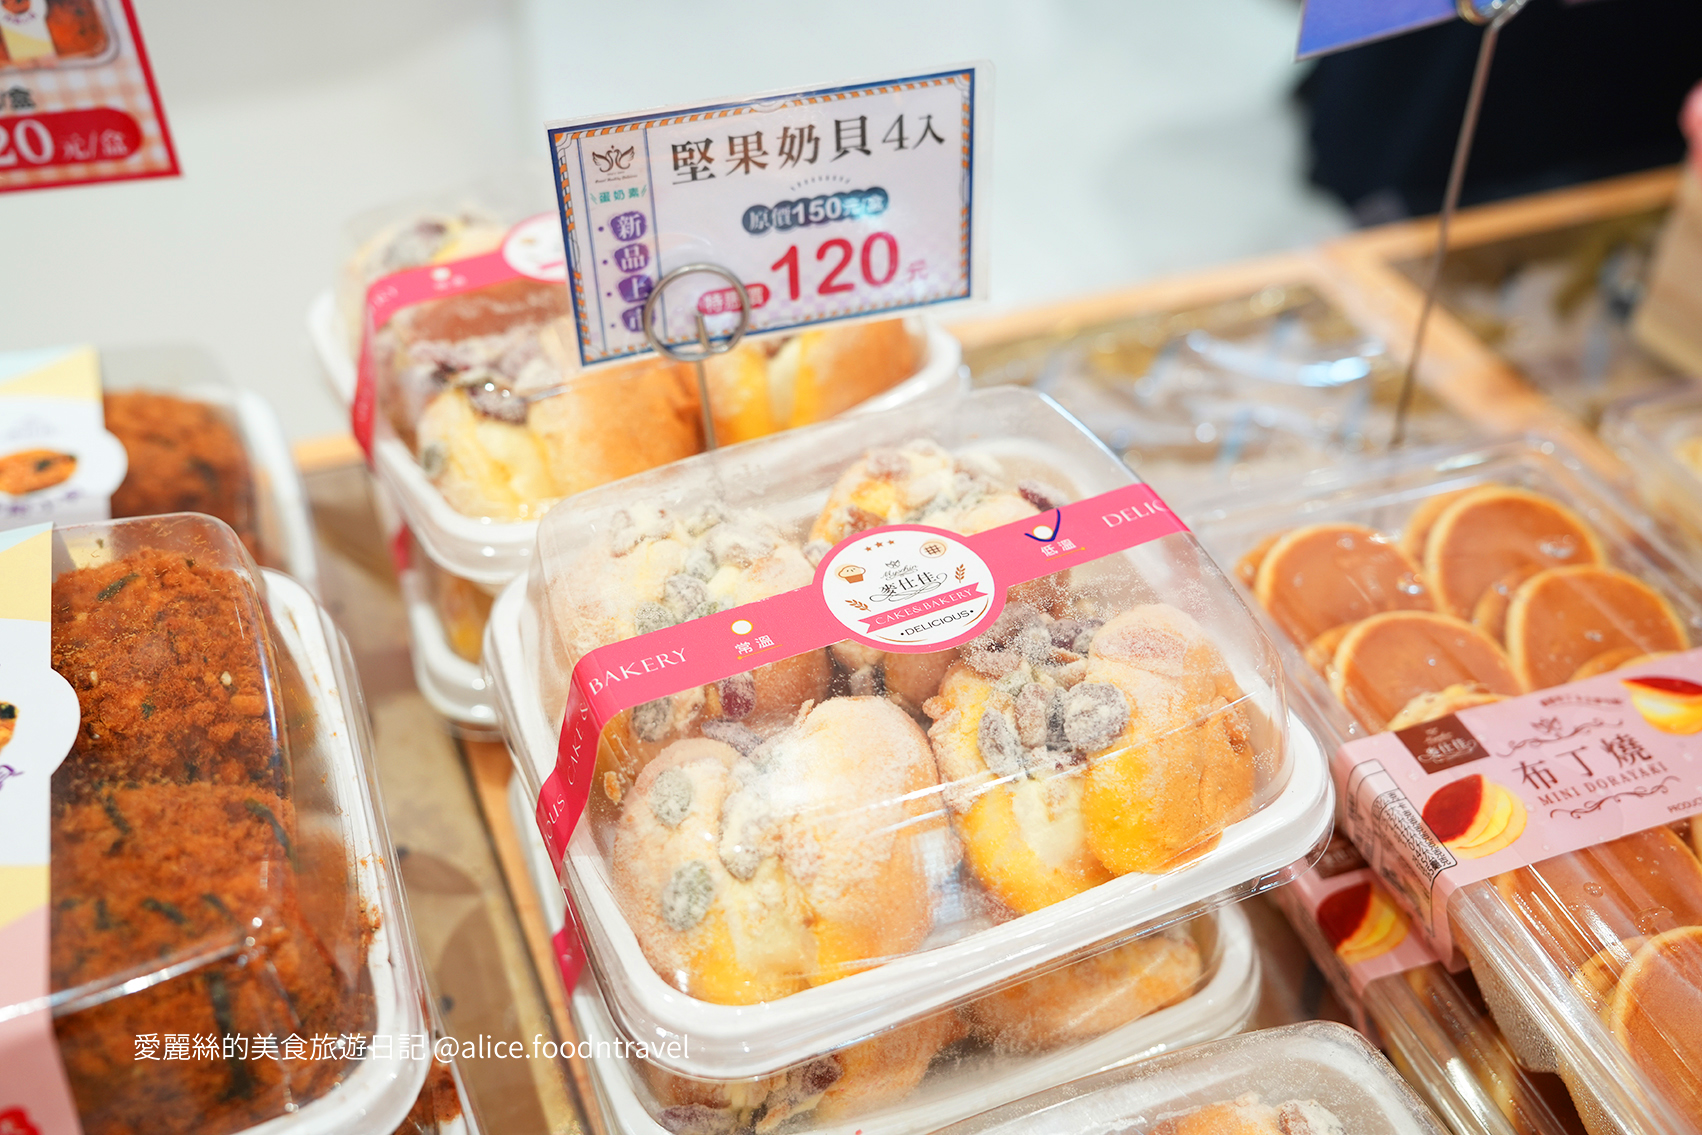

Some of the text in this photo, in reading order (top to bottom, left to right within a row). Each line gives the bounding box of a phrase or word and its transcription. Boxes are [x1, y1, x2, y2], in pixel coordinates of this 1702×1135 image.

[670, 113, 946, 186] 堅果奶貝4入
[771, 231, 899, 301] 120
[588, 647, 688, 696] BAKERY
[1512, 733, 1653, 790] 布丁燒
[1537, 760, 1669, 807] MINI DORAYAKI
